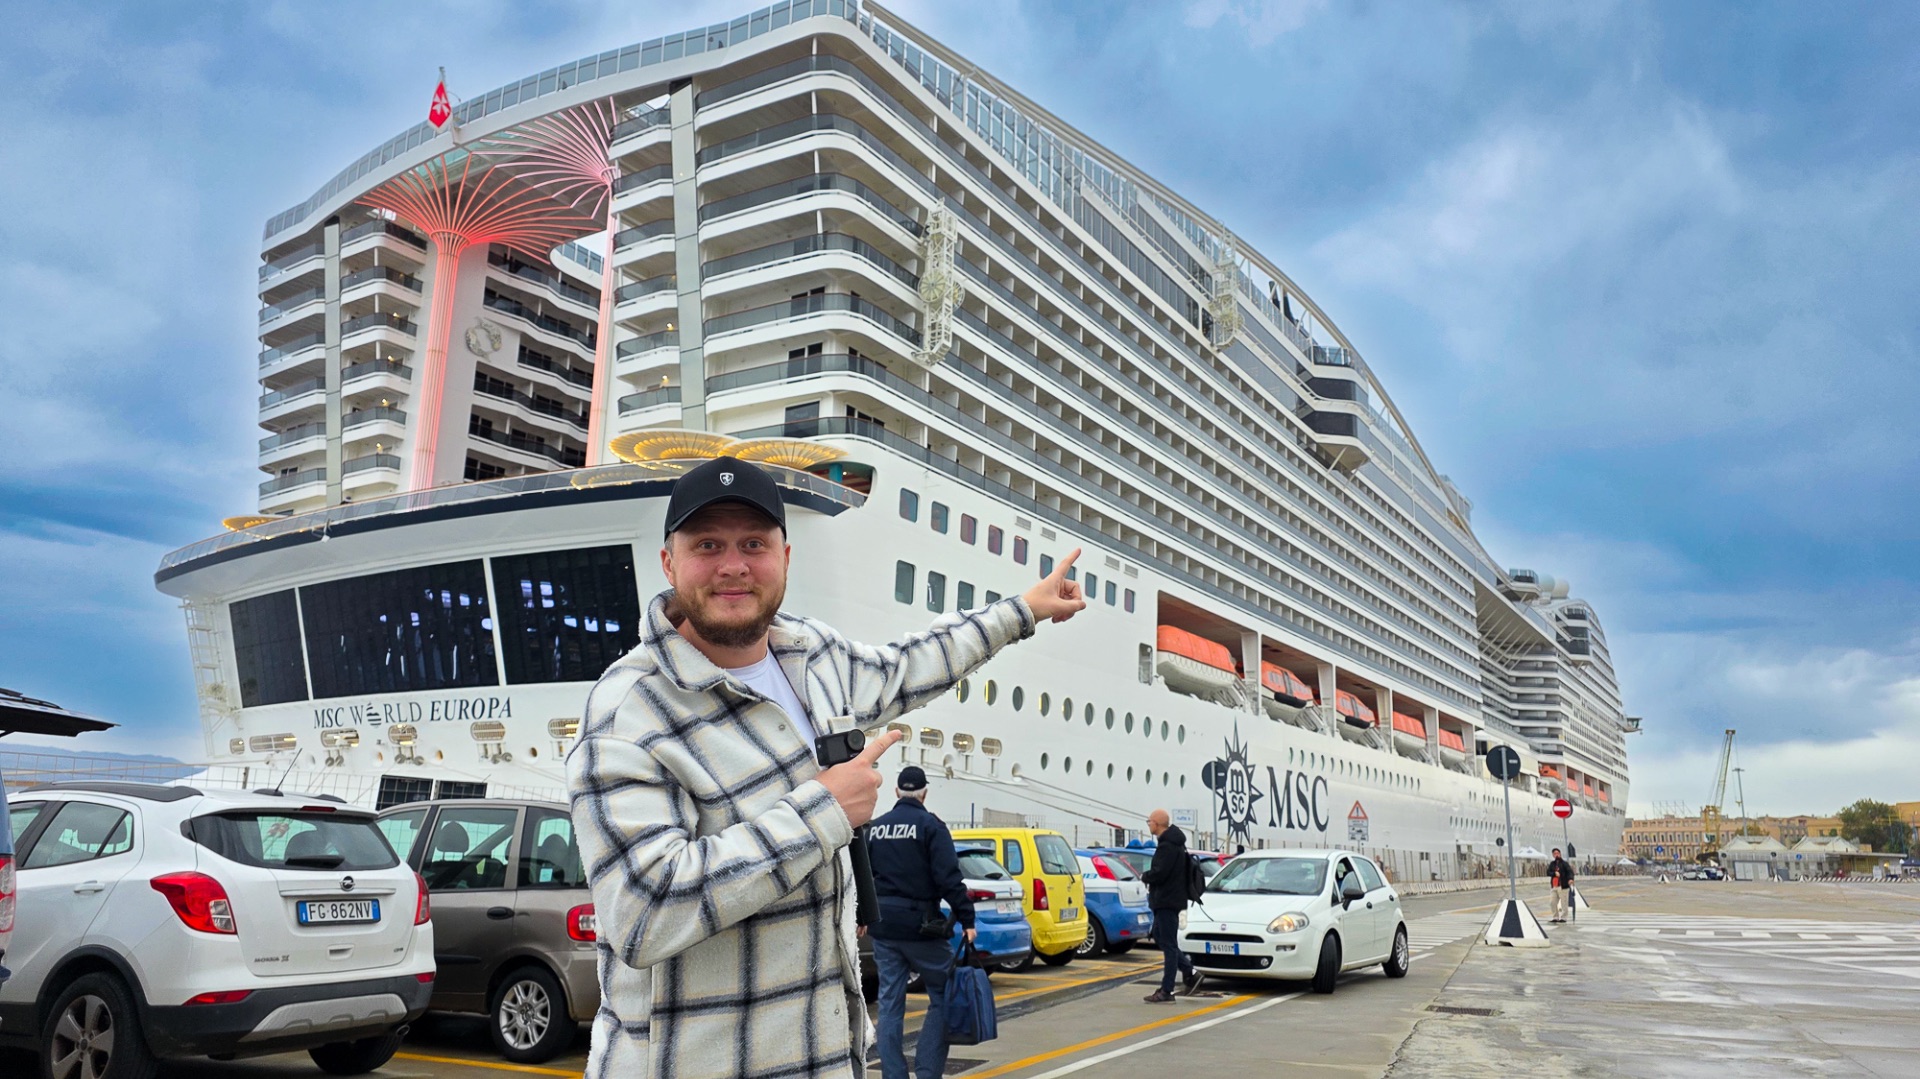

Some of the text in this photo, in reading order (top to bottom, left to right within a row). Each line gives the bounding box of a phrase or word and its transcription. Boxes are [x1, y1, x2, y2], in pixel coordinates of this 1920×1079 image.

[314, 707, 344, 729] MSC
[430, 696, 512, 722] EUROPA
[1266, 766, 1329, 832] MSC
[869, 824, 917, 841] POLIZIA
